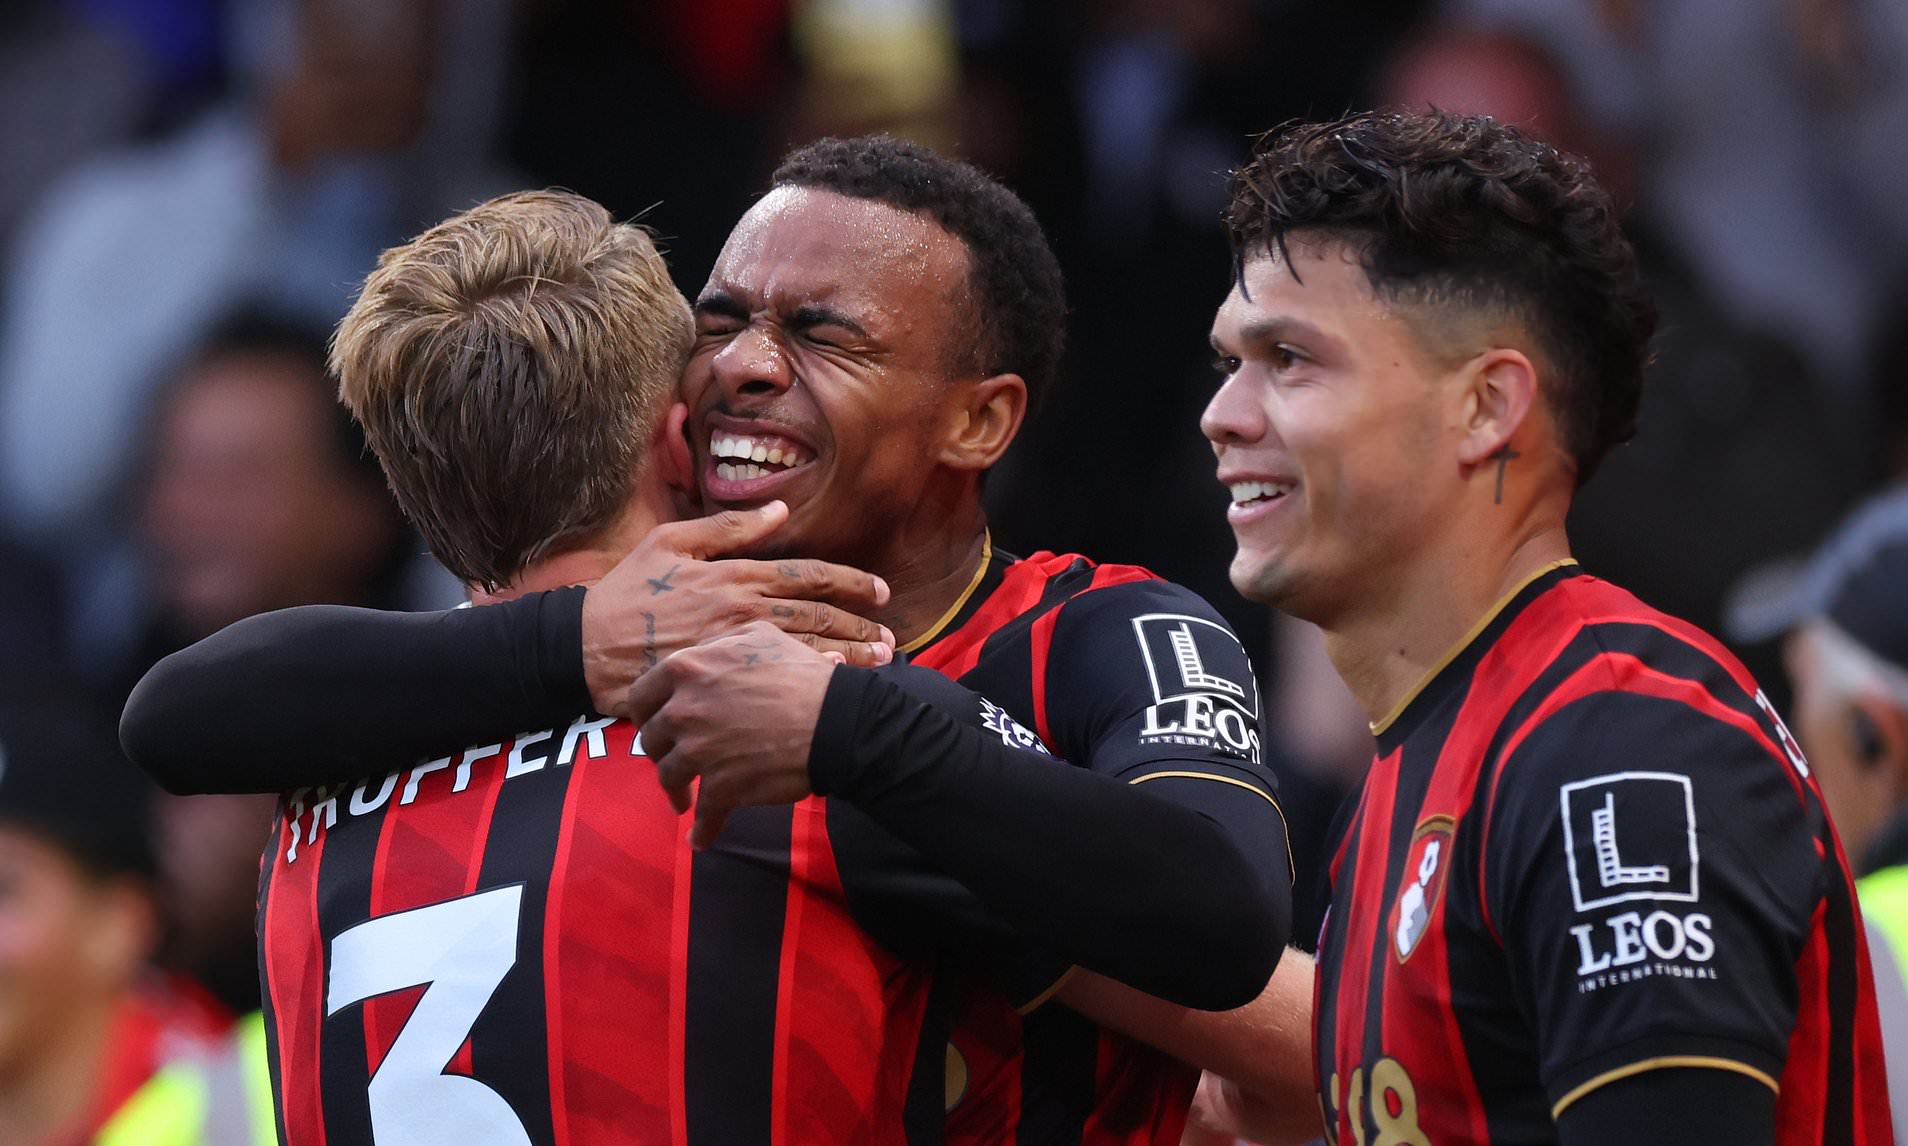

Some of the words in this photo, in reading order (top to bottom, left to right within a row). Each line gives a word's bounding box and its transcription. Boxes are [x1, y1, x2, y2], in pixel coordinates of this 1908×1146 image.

[286, 714, 649, 864] TRUFFER
[1569, 911, 1715, 976] LEOS
[1578, 962, 1718, 993] INTERNATIONAL
[328, 884, 533, 1146] 3
